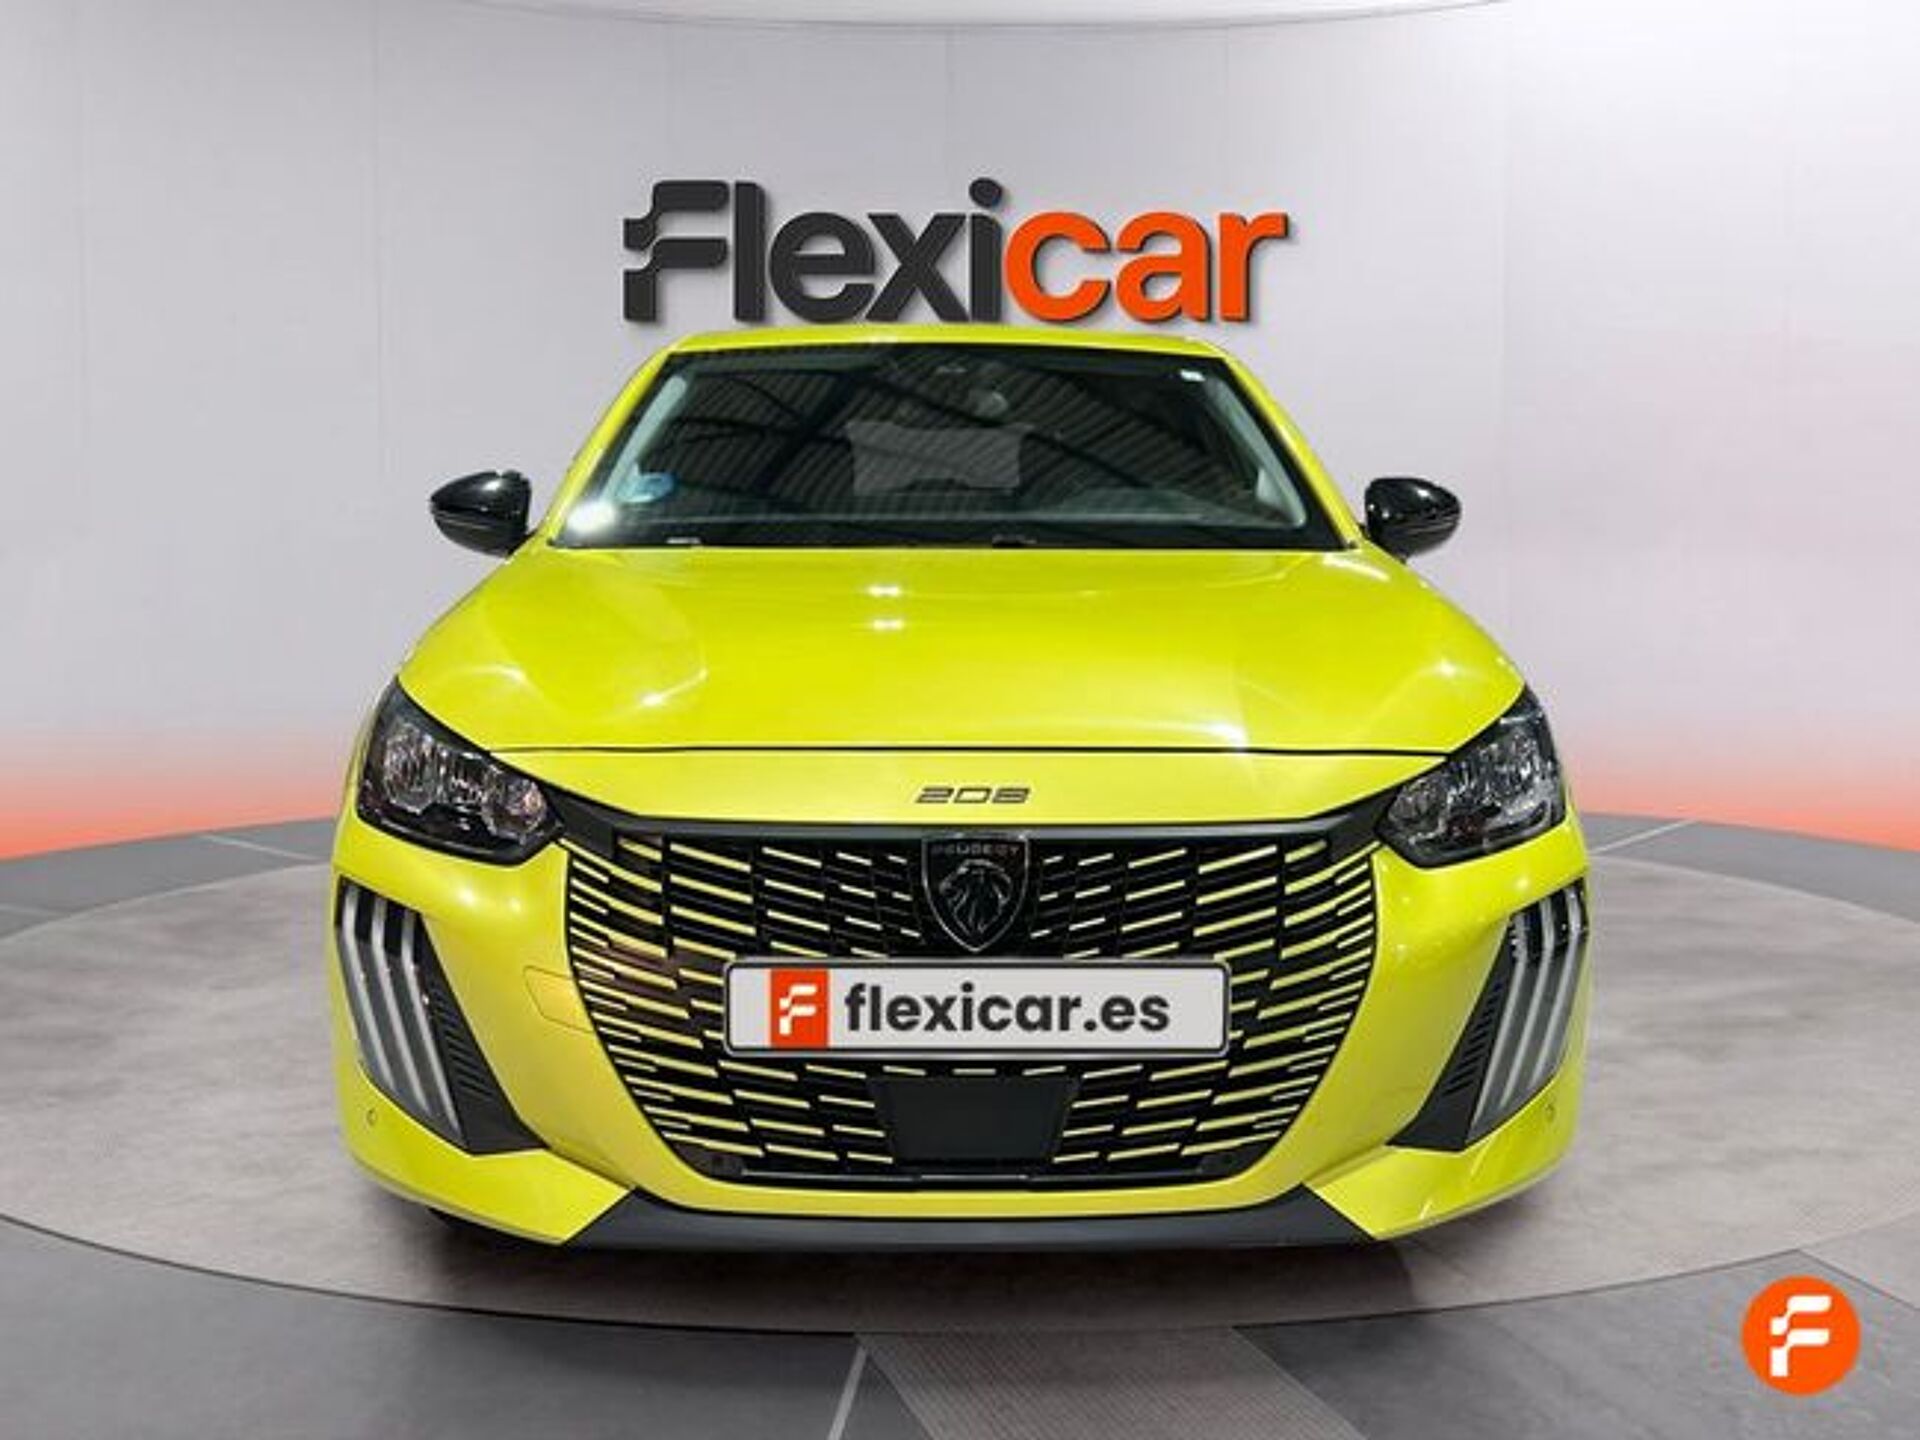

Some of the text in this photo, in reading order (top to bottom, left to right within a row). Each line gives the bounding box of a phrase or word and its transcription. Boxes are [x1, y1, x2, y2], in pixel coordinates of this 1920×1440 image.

[623, 178, 1290, 322] Flexicar
[915, 786, 1030, 804] 208
[844, 982, 1169, 1032] flexicar.es
